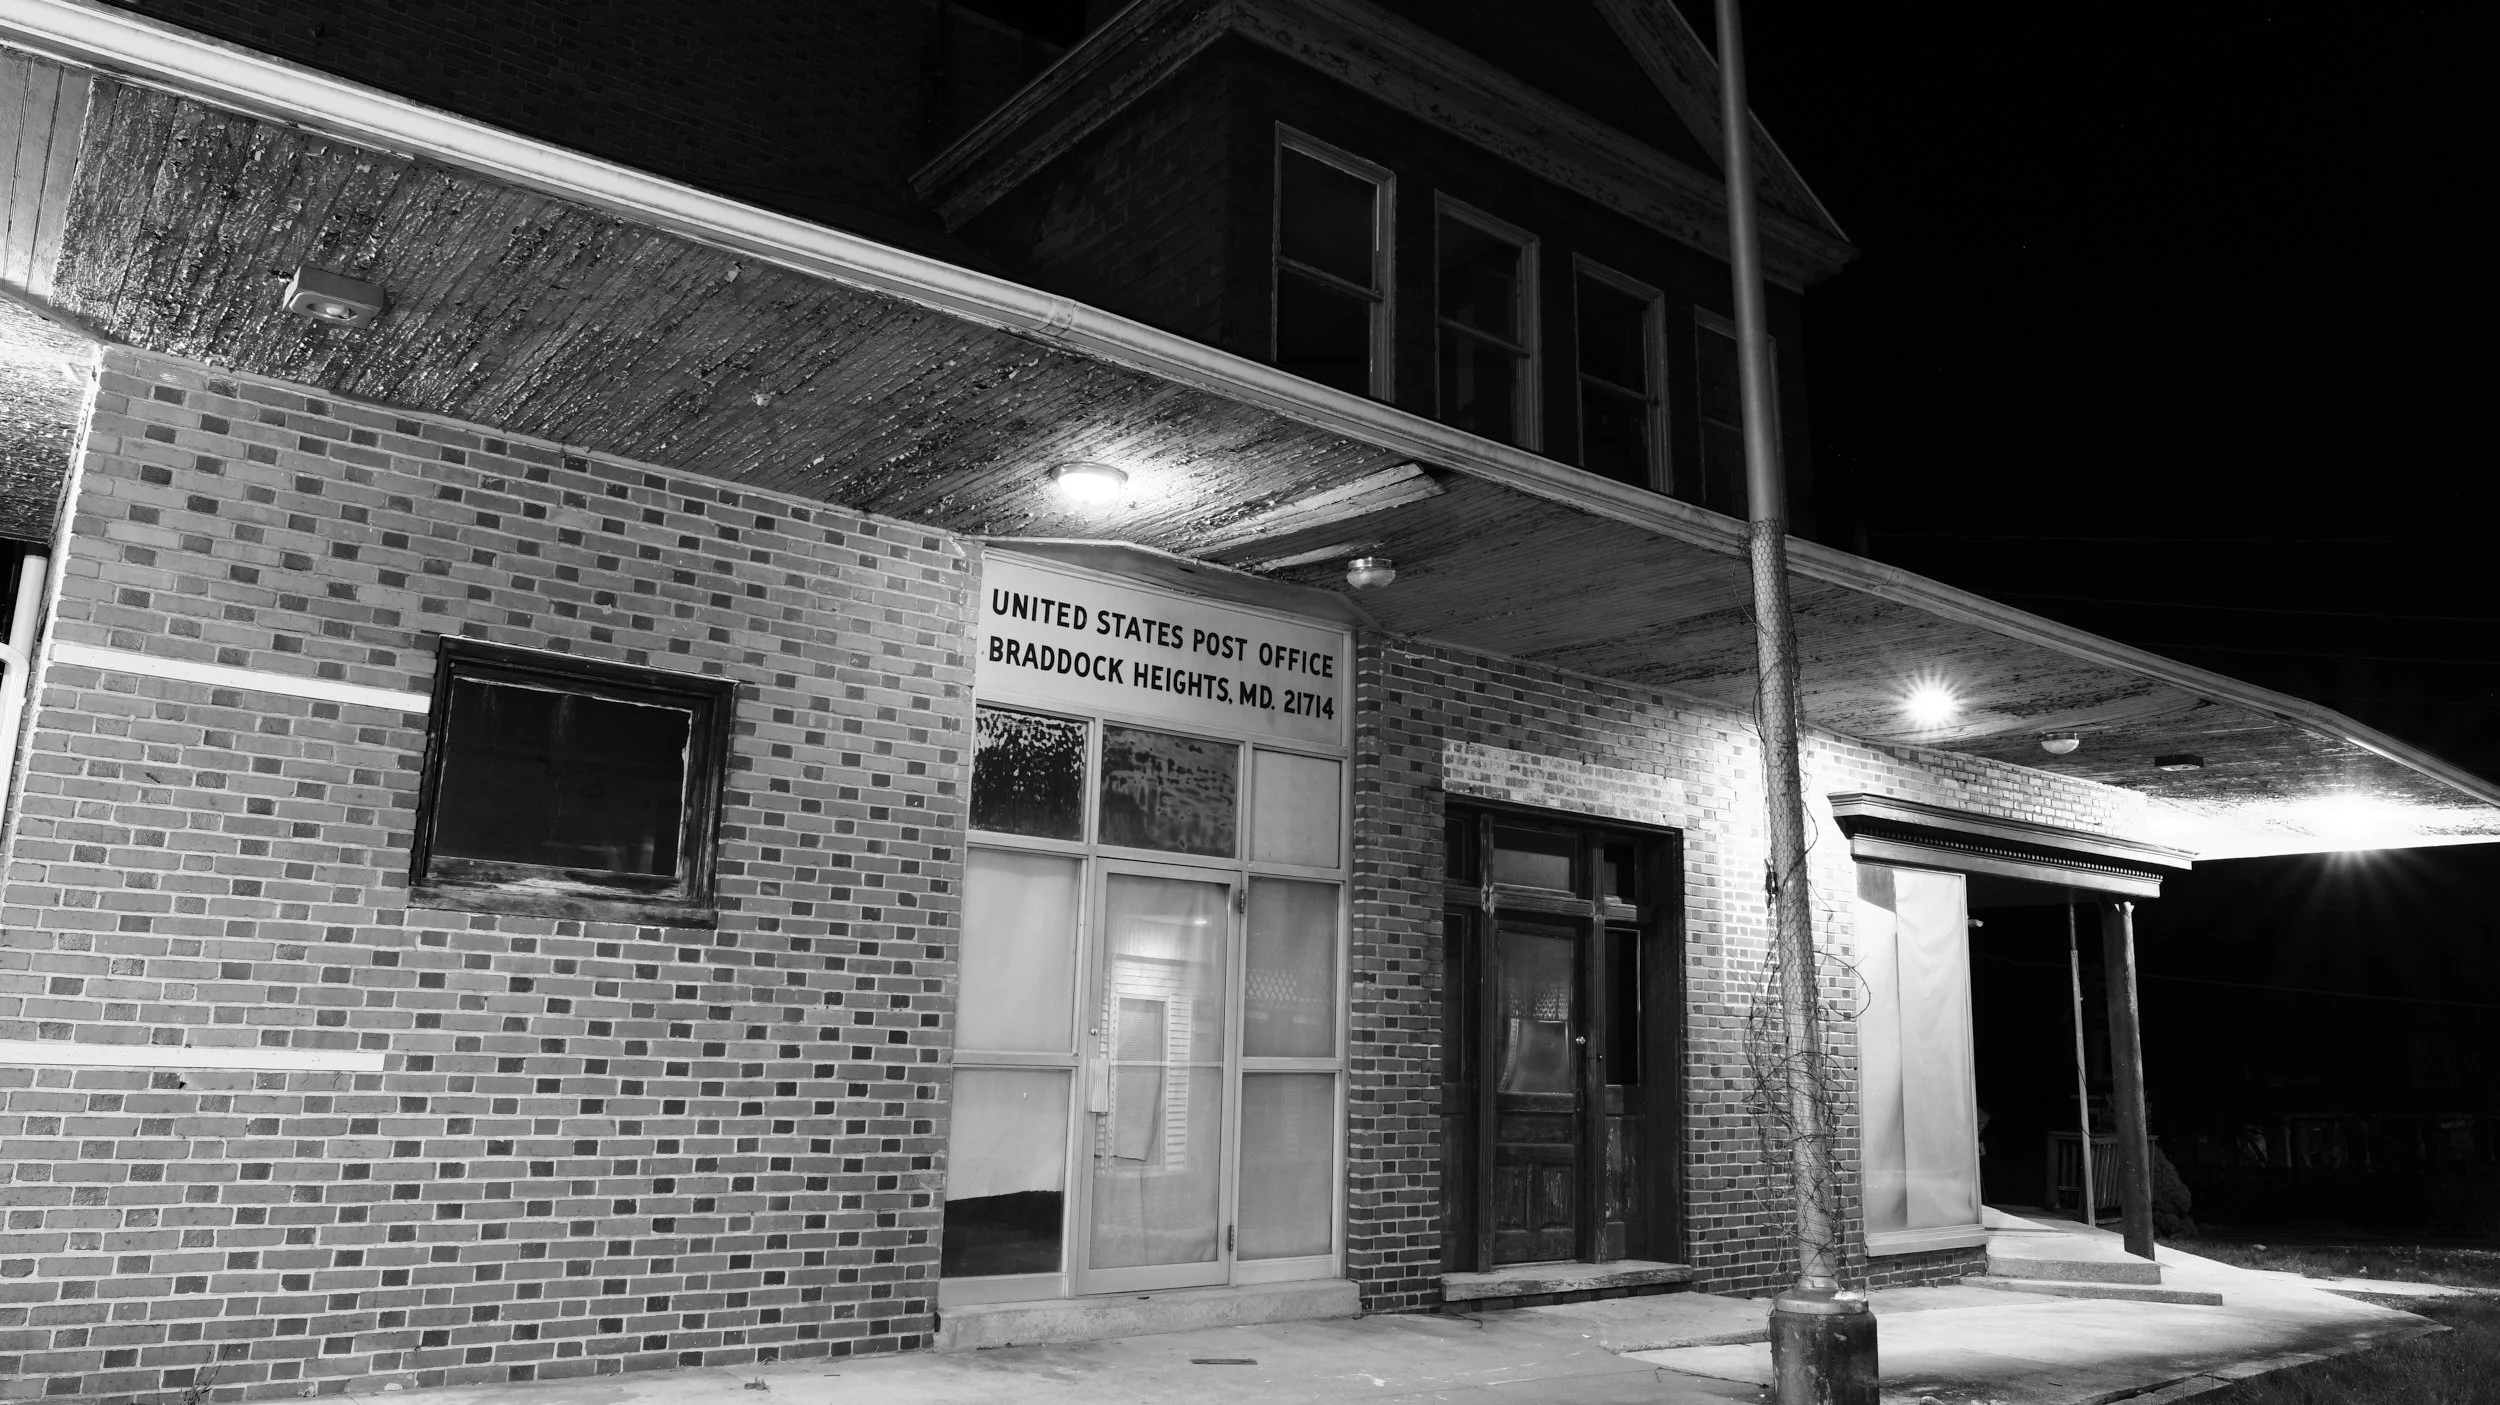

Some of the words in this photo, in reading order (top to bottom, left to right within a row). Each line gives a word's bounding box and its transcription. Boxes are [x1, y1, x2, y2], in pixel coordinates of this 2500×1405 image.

[989, 635, 1124, 685] BRADDOCK
[1133, 661, 1233, 706] HEIGHTS,
[1239, 680, 1276, 711] MD.
[1283, 689, 1335, 721] 21714
[992, 588, 1088, 631] UNITED
[1096, 610, 1184, 650] STATES
[1192, 628, 1248, 662] POST
[1258, 642, 1334, 680] OFFICE
